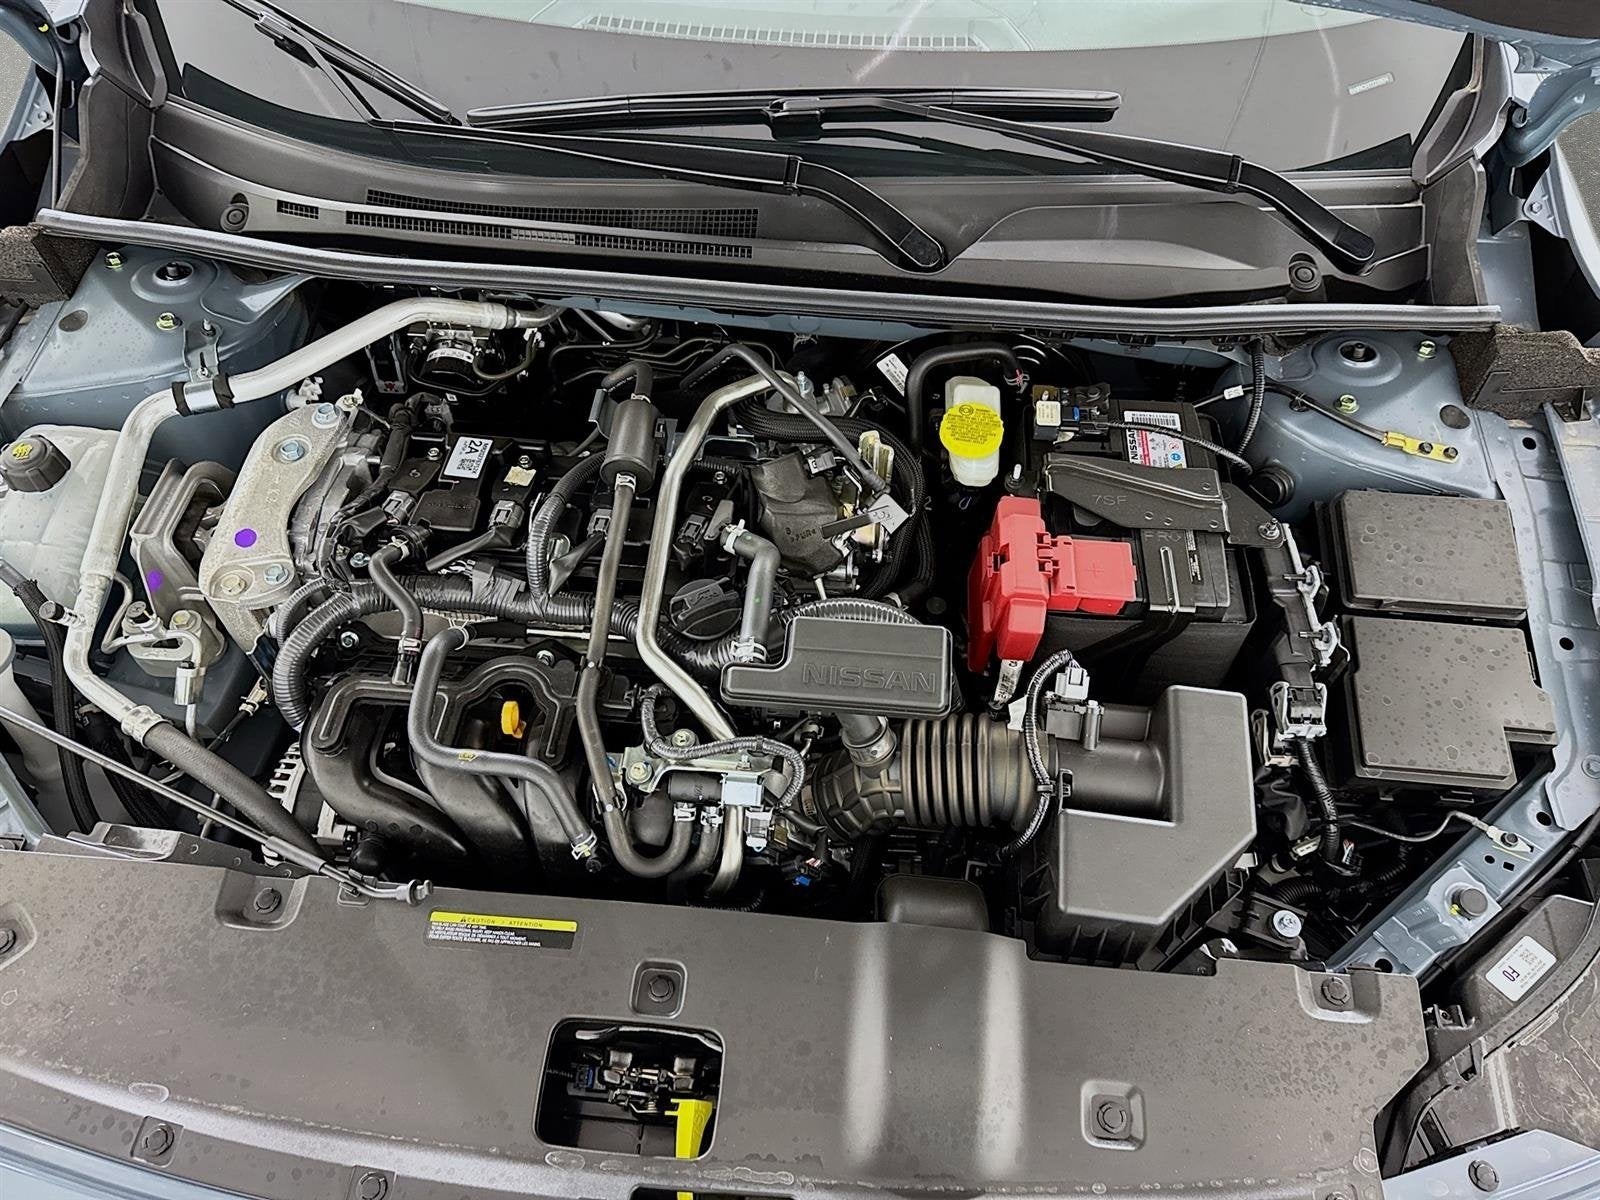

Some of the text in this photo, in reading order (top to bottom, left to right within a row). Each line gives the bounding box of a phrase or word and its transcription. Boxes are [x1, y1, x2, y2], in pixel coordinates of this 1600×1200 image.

[465, 440, 483, 454] 2A
[801, 662, 936, 694] NISSAN
[467, 917, 495, 925] CAUTION
[509, 920, 543, 928] ATTENTION
